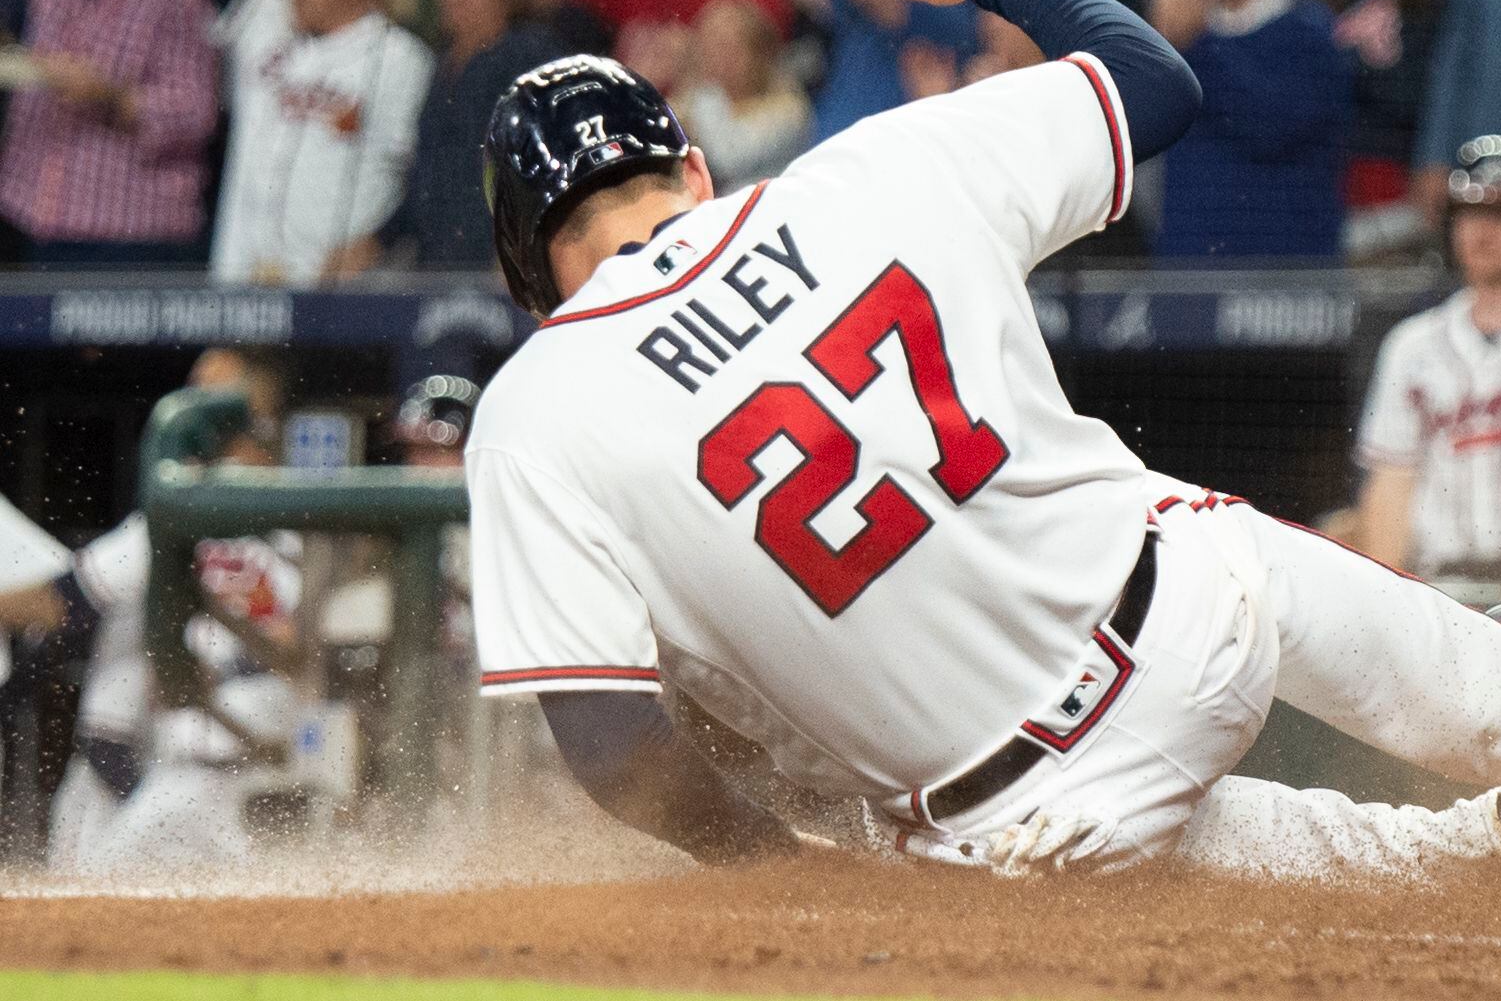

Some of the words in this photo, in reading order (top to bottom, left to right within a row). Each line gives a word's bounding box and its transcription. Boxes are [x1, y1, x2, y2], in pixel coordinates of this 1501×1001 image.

[574, 115, 607, 146] 27
[636, 223, 821, 395] RILEY
[697, 258, 1011, 619] 27
